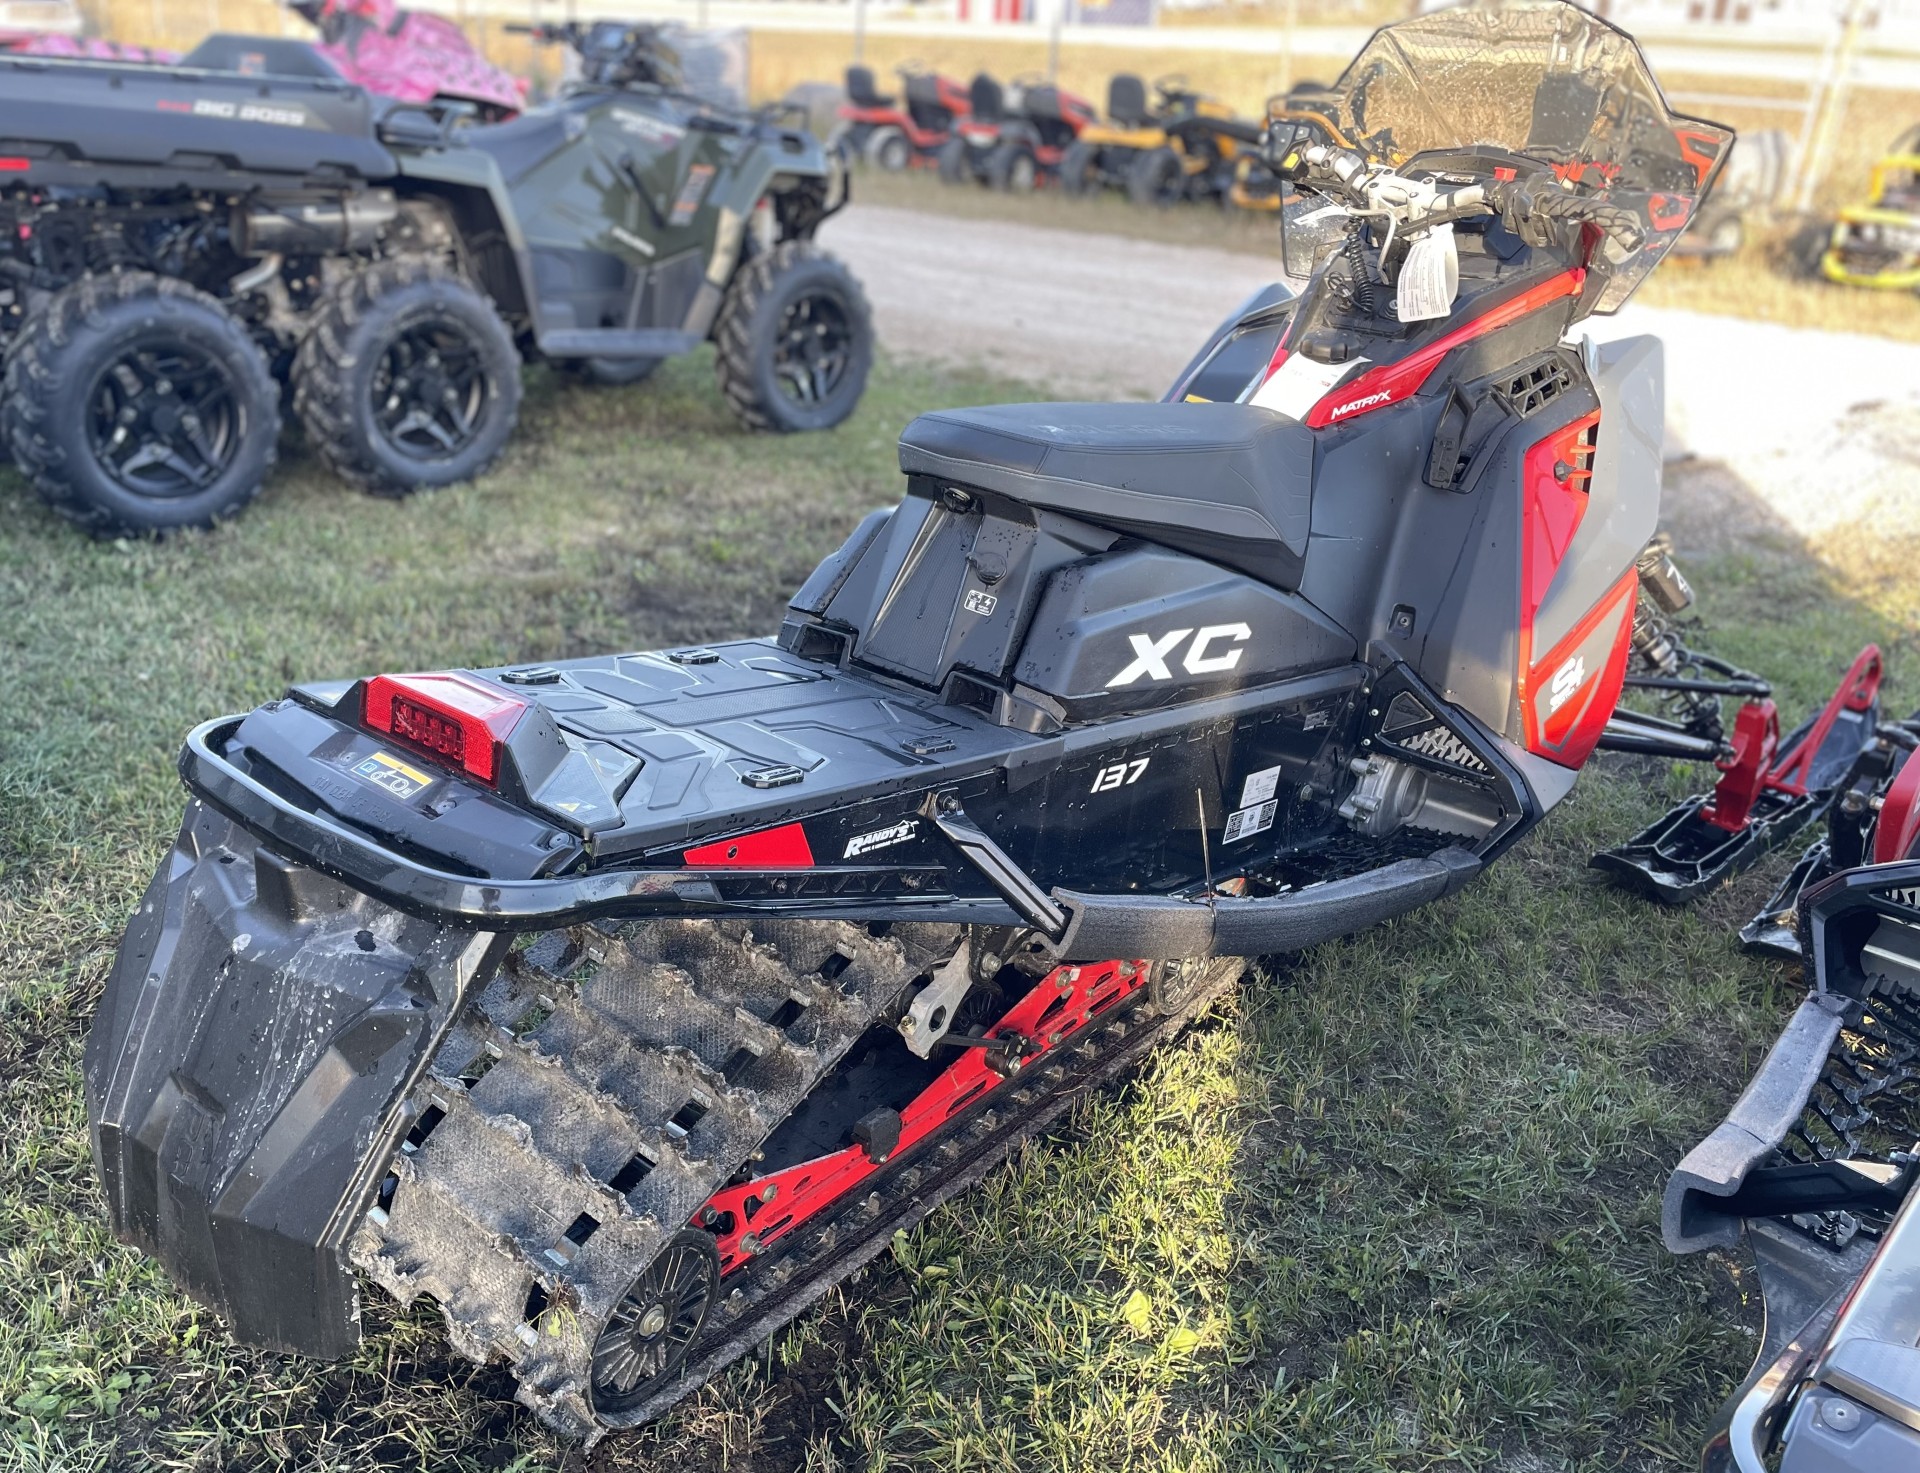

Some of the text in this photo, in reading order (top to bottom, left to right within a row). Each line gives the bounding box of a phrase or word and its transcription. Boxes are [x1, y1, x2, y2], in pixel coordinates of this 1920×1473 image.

[193, 99, 236, 118] BIG
[239, 105, 306, 127] BOSS
[1331, 389, 1391, 420] MATRYX
[1105, 622, 1251, 687] XC
[1090, 757, 1150, 794] 137
[843, 824, 910, 859] RANDY'S
